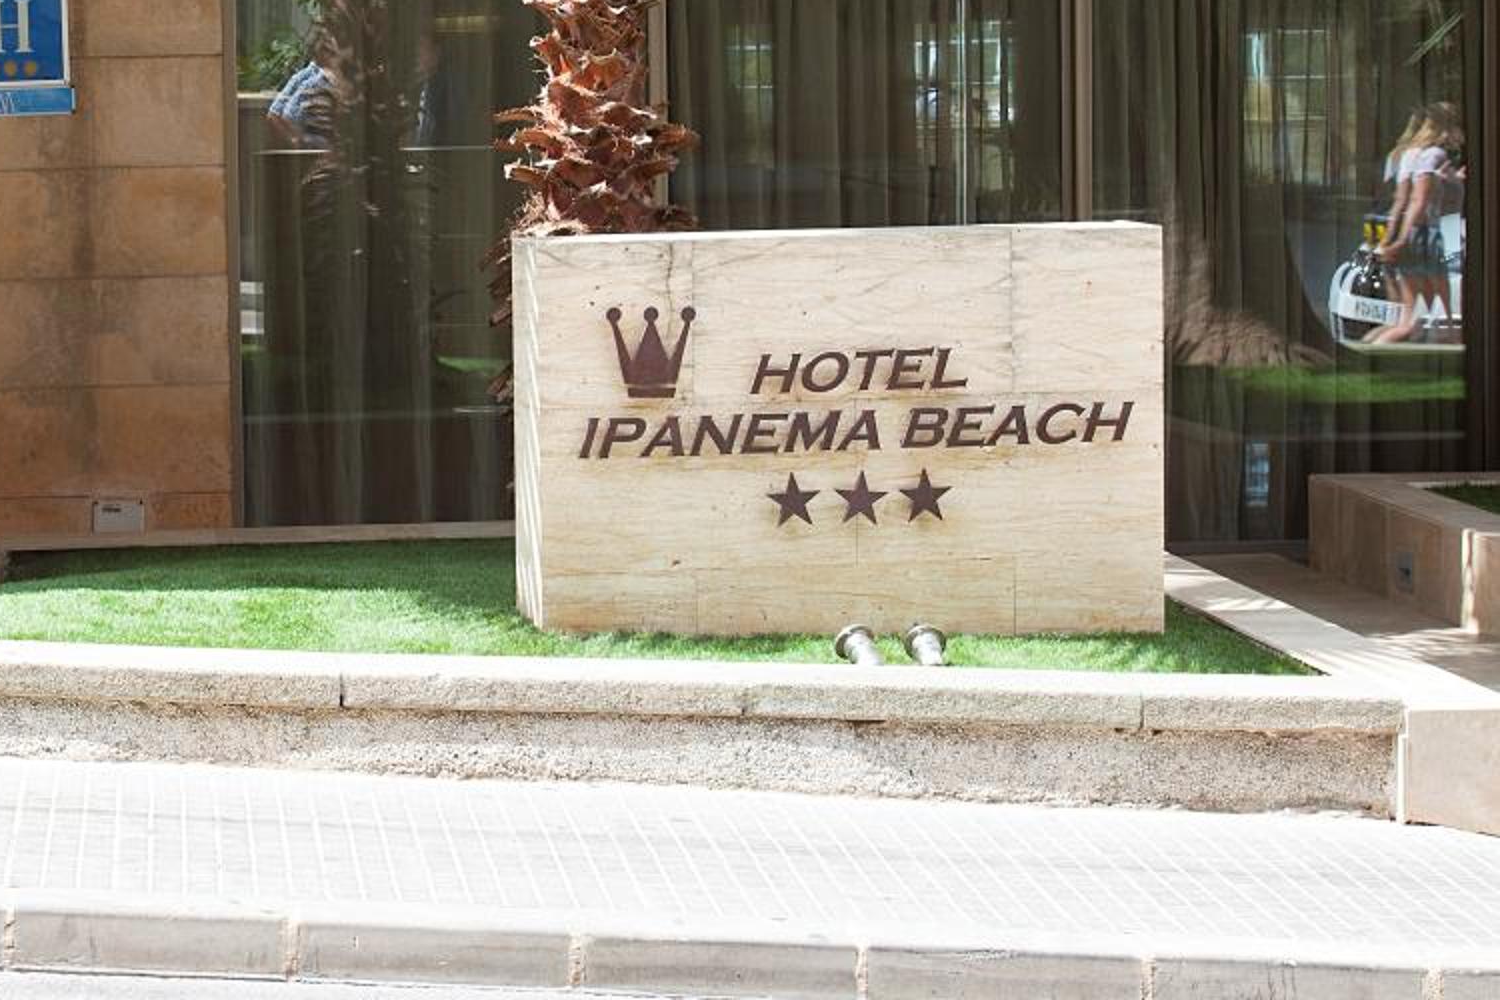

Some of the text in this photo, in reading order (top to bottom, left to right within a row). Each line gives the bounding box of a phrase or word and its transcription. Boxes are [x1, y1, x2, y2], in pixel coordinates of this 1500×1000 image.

[750, 347, 969, 395] HOTEL
[578, 401, 1135, 459] IPANEMA BEACH
